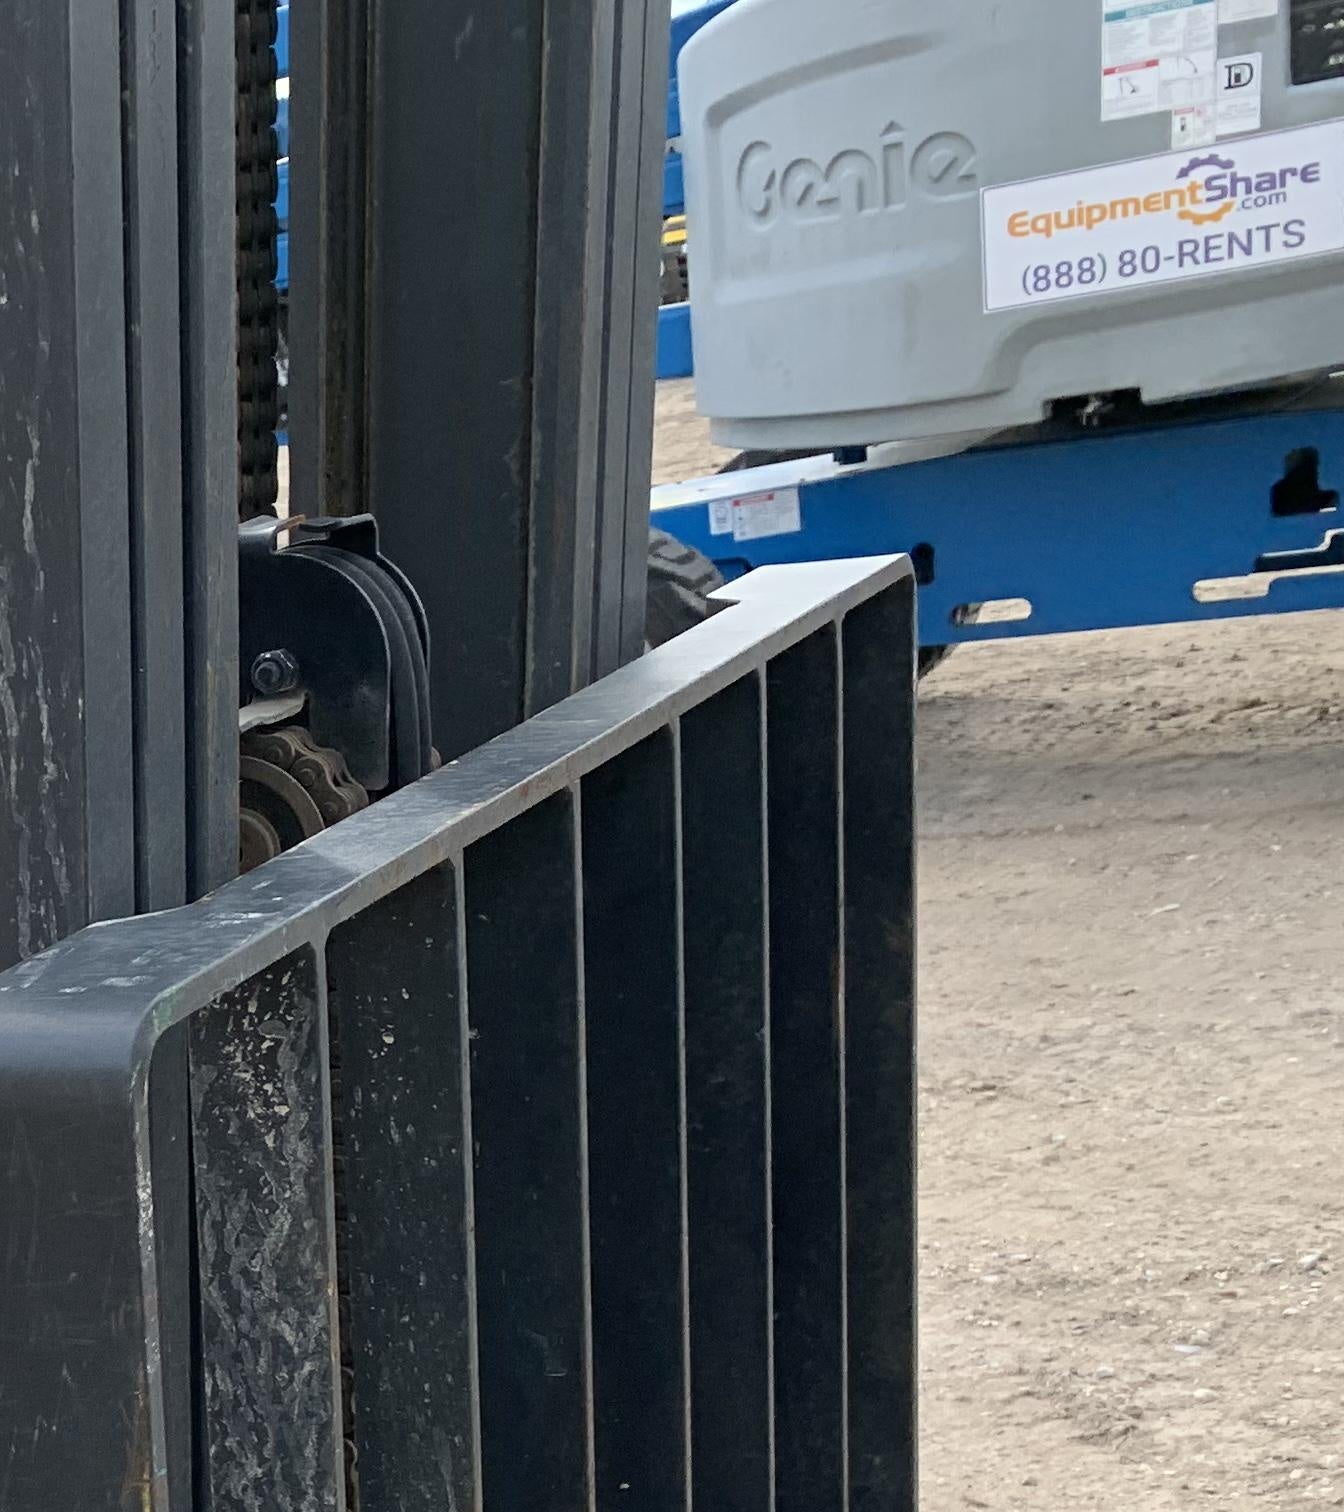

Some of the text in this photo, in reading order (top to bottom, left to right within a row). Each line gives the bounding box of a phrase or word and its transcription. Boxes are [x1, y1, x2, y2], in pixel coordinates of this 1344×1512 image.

[736, 120, 977, 232] Genie
[1007, 161, 1320, 239] EquipmentShare
[1235, 190, 1287, 212] .com
[1021, 219, 1307, 296] (888) 80-RENTS
